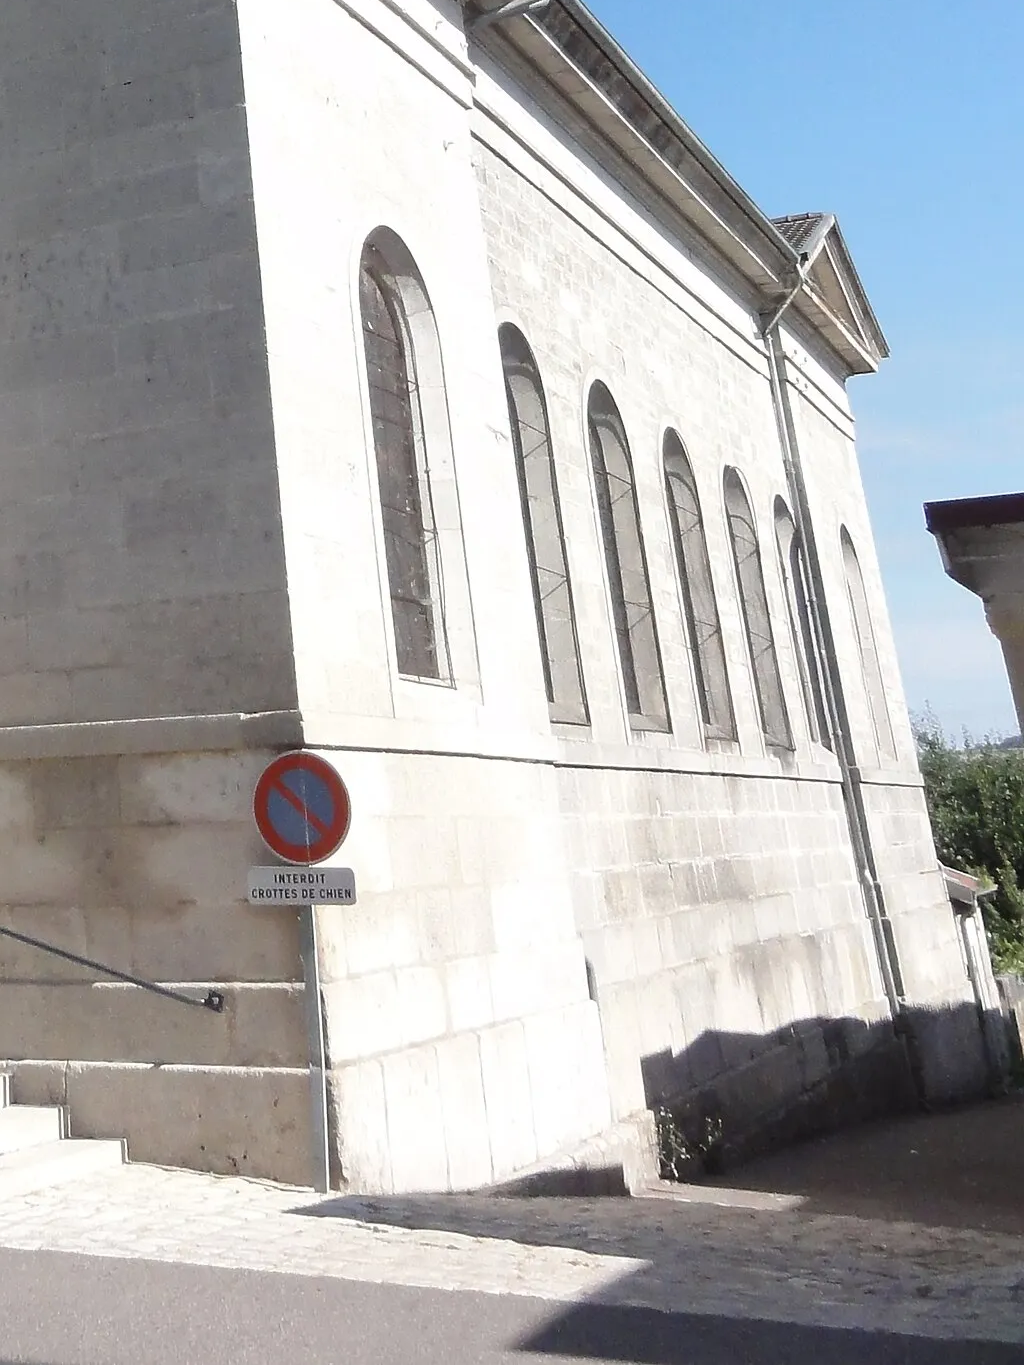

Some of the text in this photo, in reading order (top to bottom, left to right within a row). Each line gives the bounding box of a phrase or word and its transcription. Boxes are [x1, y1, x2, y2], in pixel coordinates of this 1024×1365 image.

[274, 873, 326, 884] INTERDIT
[251, 888, 352, 899] CROTTES DE CHIEN
